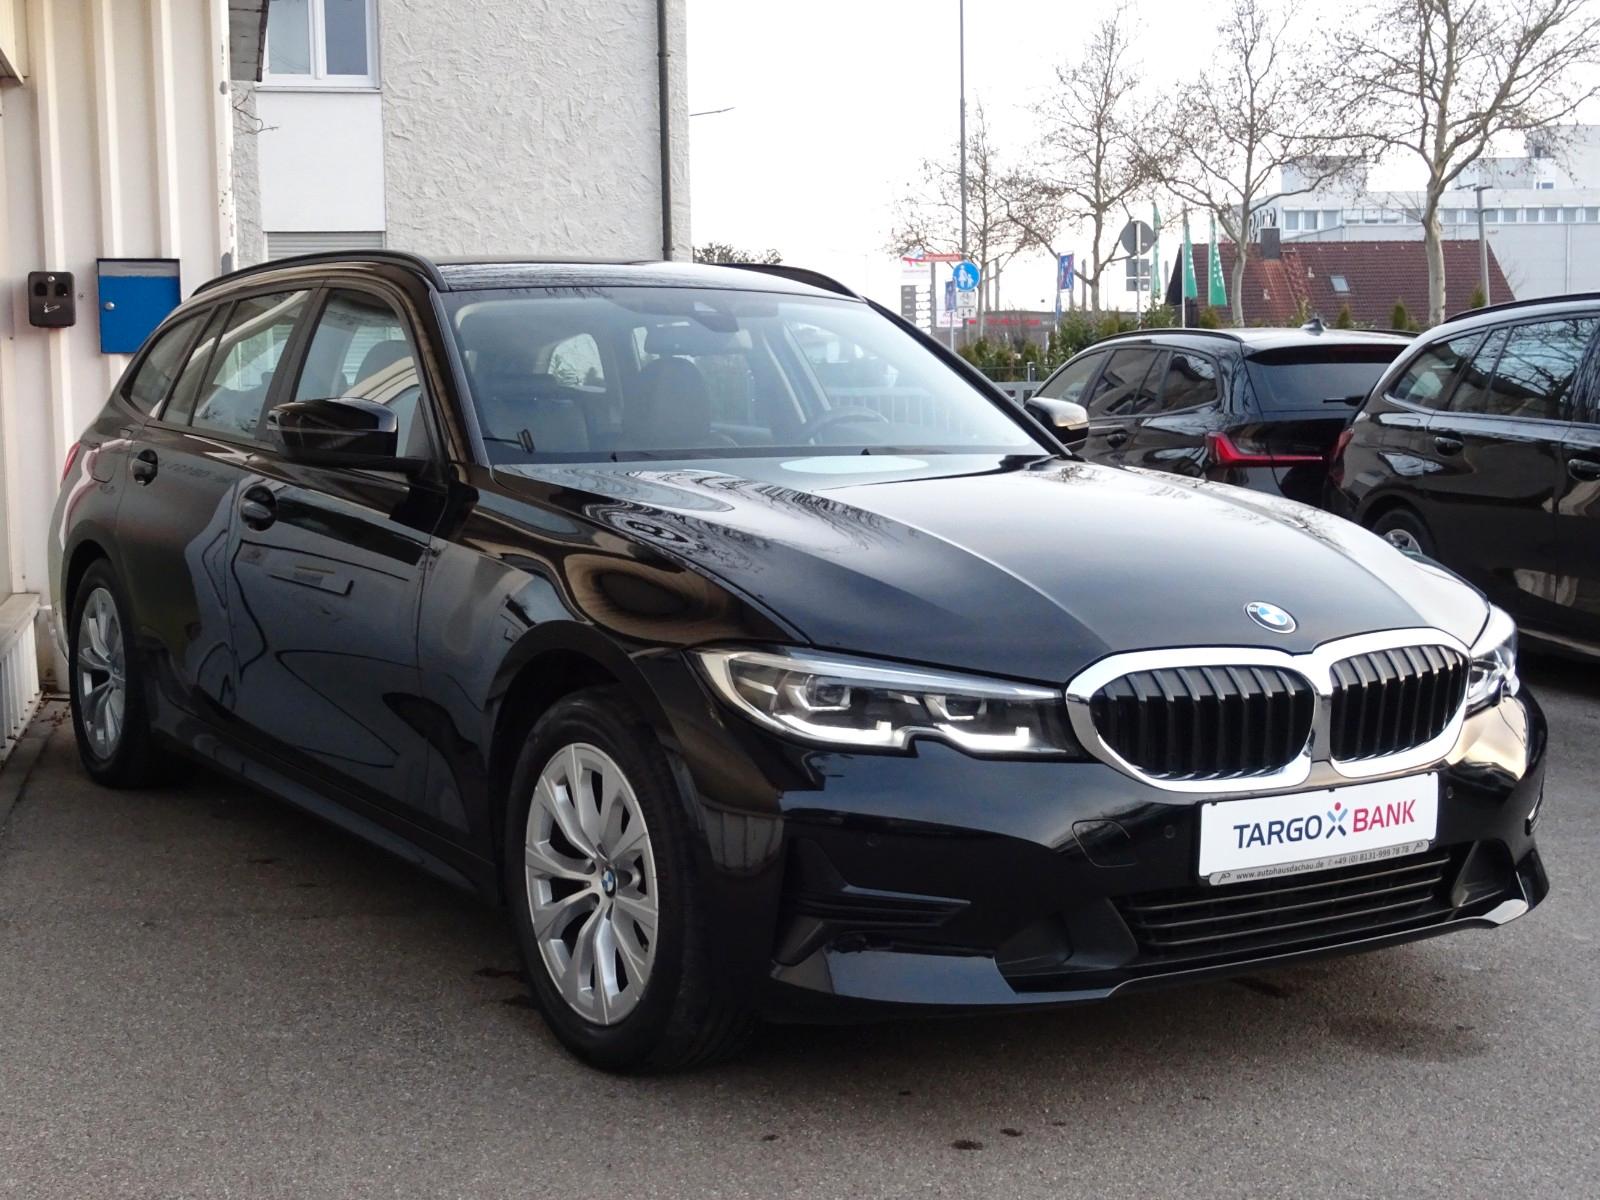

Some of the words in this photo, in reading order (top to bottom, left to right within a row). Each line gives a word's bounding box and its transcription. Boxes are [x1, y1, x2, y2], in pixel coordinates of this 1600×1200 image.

[1233, 815, 1323, 849] TARGO
[1352, 799, 1416, 833] BANK
[1236, 861, 1324, 879] www.autohausdachau.de
[1334, 857, 1347, 865] +49
[1348, 854, 1358, 865] (0)
[1359, 849, 1391, 862] 8131-999
